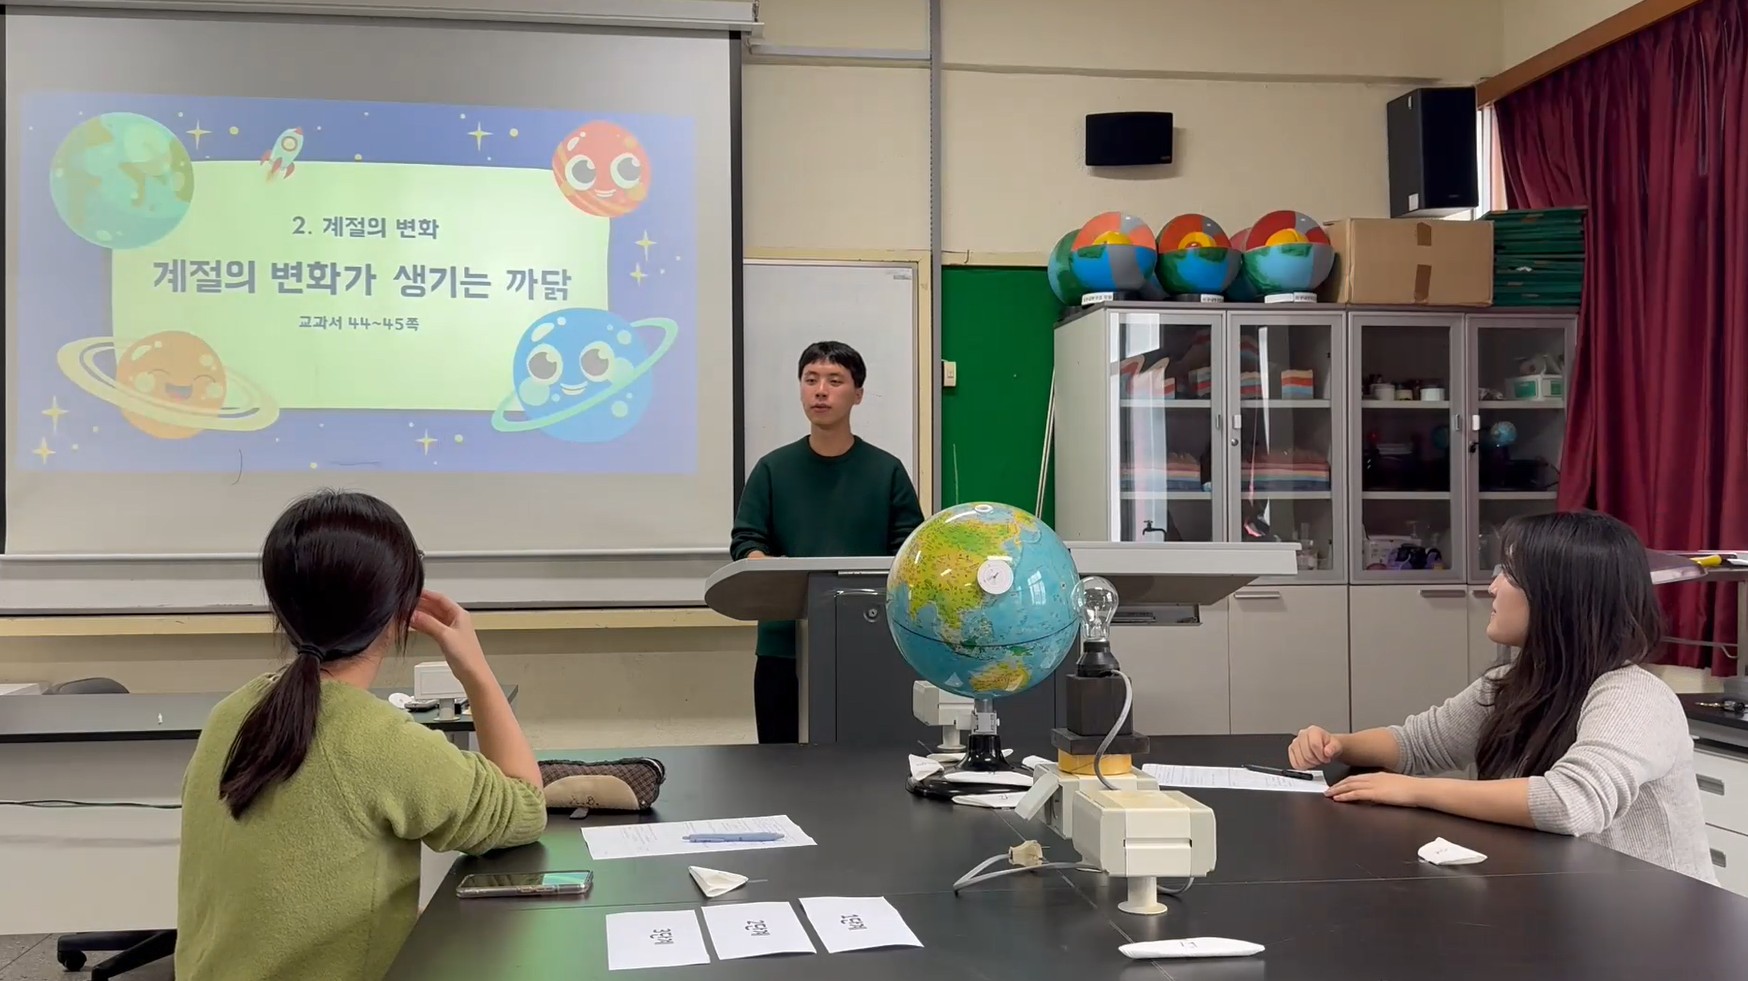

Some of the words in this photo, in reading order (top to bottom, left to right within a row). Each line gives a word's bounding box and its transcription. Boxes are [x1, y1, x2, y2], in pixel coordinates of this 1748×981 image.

[293, 215, 312, 235] 2.
[322, 215, 387, 239] 계절의
[396, 218, 440, 240] 변화
[153, 258, 256, 294] 계절의
[271, 260, 377, 297] 변화가
[392, 264, 492, 299] 생기는
[506, 268, 572, 301] 까닭
[298, 315, 343, 330] 교과서
[348, 316, 420, 332] 44~45쪽
[649, 928, 674, 945] 3단계
